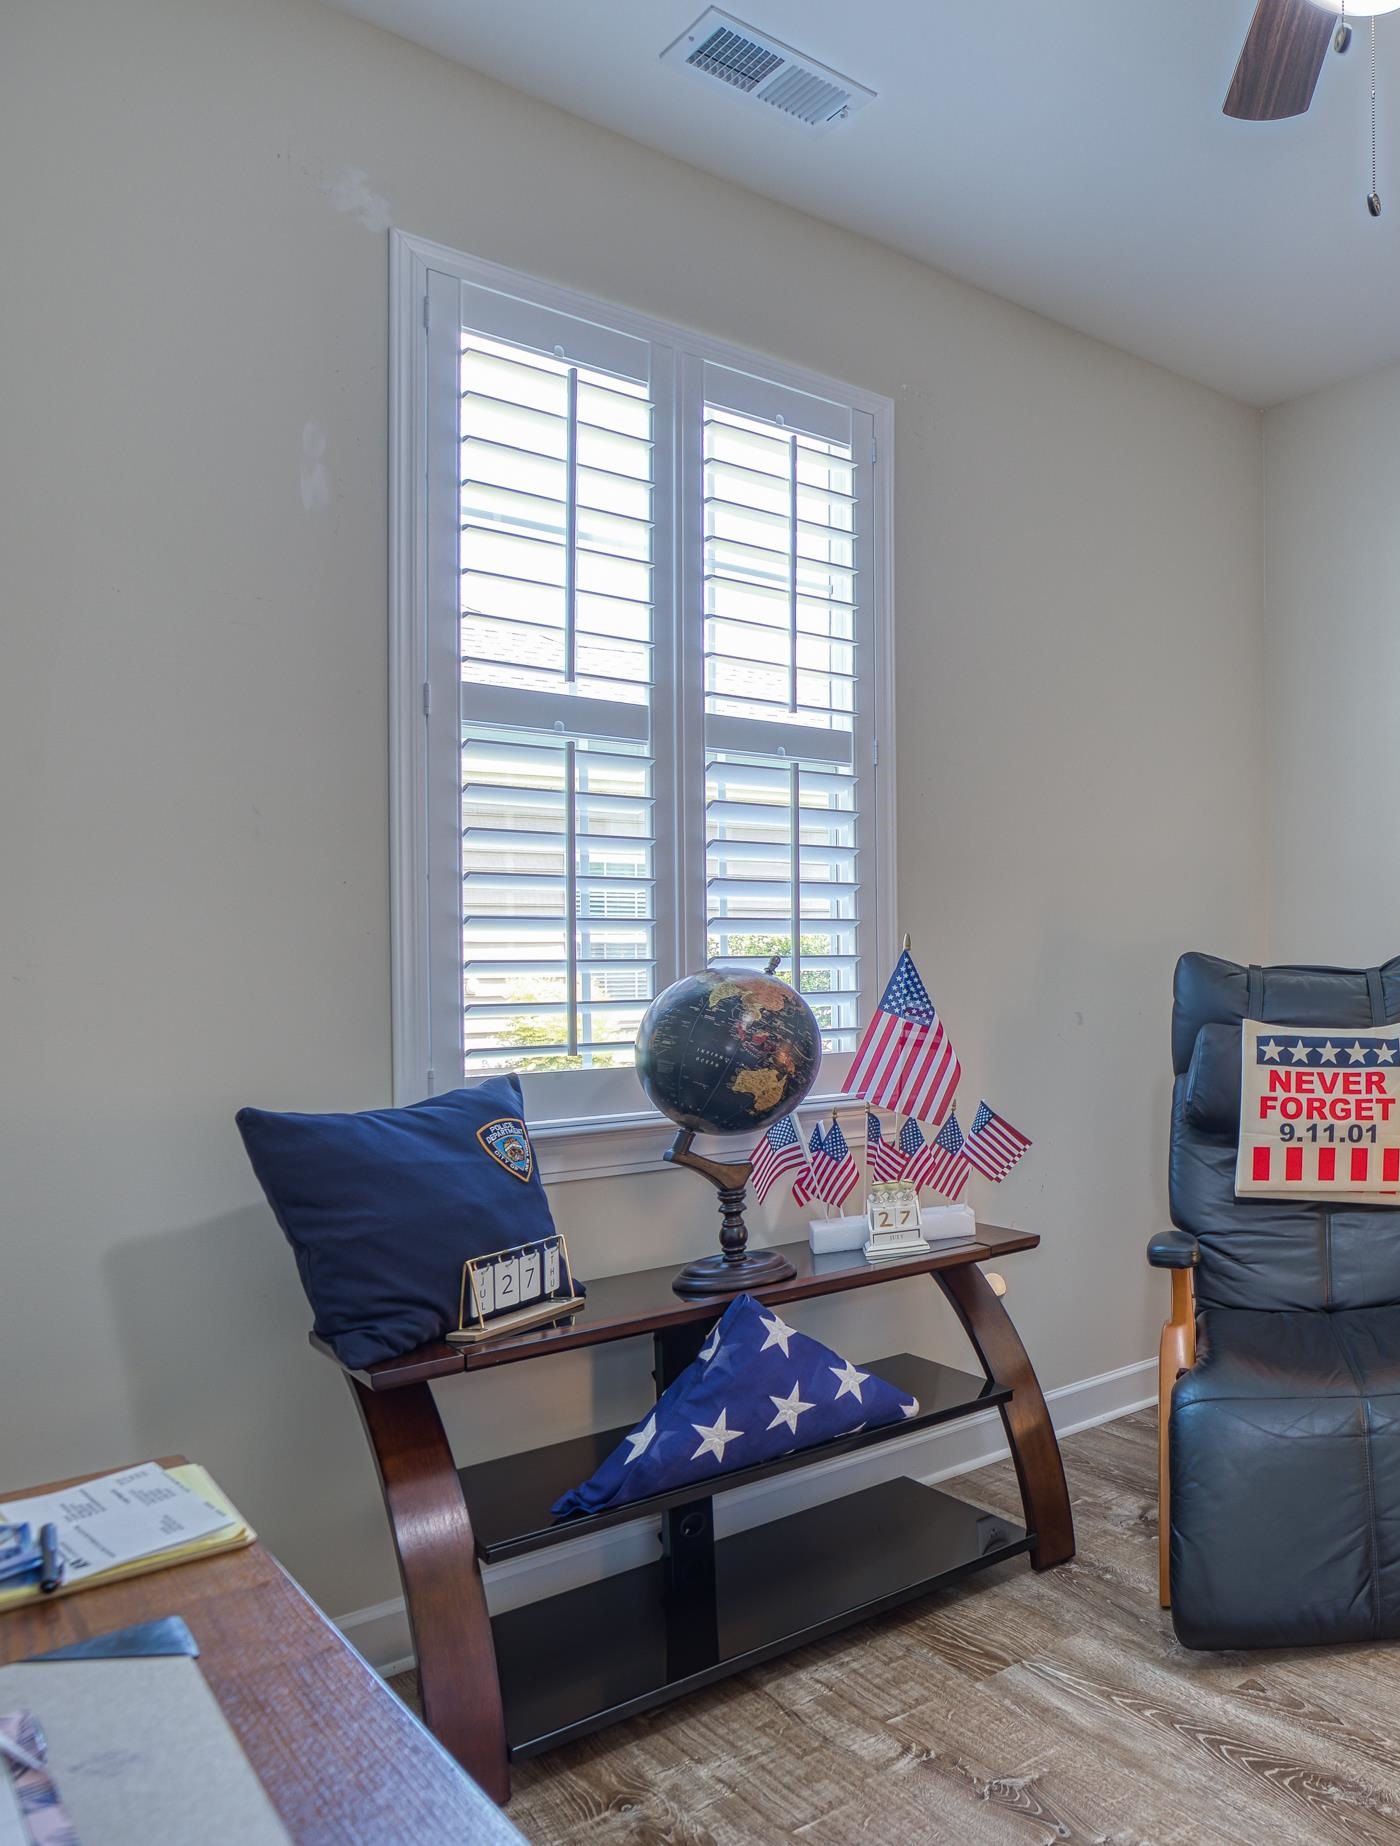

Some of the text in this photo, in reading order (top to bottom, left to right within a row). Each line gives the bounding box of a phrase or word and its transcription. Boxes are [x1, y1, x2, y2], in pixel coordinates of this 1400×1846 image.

[1268, 1069, 1387, 1095] NEVER
[1259, 1095, 1396, 1121] FORGET
[490, 1121, 514, 1133] POLICE
[1279, 1122, 1377, 1143] 9.11.01
[494, 1150, 509, 1164] CITY
